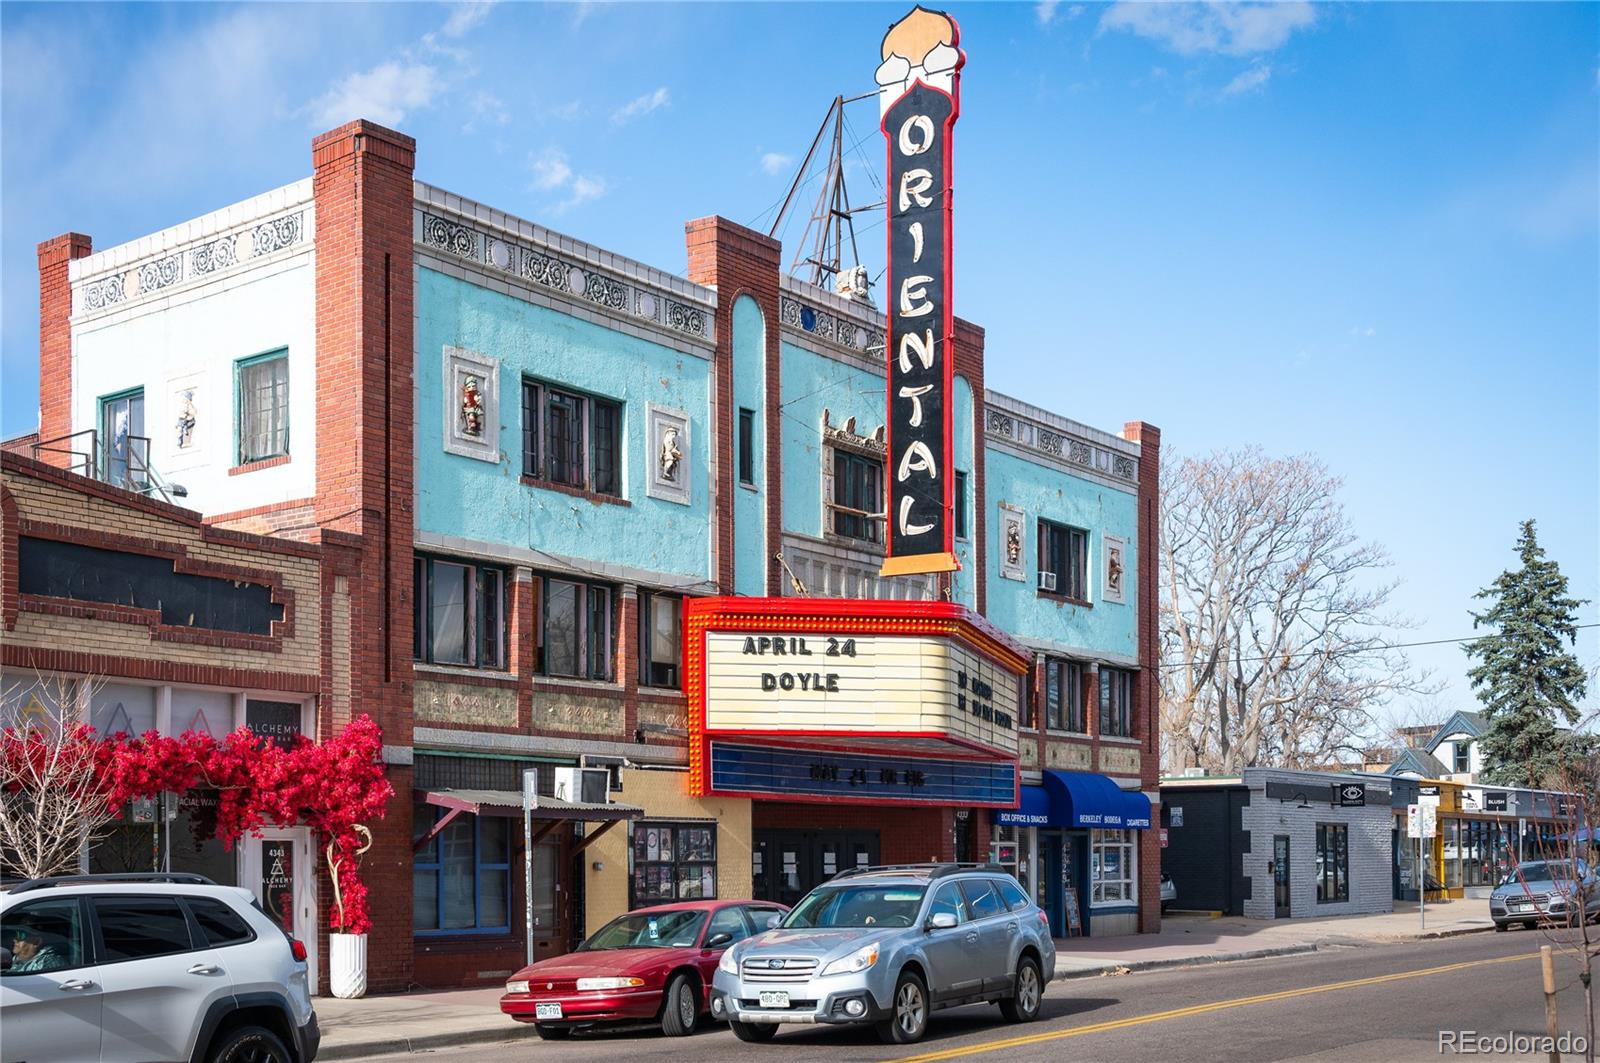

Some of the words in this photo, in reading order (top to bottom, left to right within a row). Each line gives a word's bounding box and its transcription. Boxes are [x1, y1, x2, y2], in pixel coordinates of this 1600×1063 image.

[899, 114, 937, 538] ORIENTAL
[742, 636, 812, 656] APRIL
[826, 637, 857, 658] 24
[761, 672, 840, 693] DOYLE
[247, 722, 299, 735] ALCHEMY
[1001, 813, 1010, 822] BOX
[1011, 814, 1026, 823] OFFICE
[1031, 815, 1048, 824] SNACKS
[1126, 818, 1149, 827] CIGARETTES
